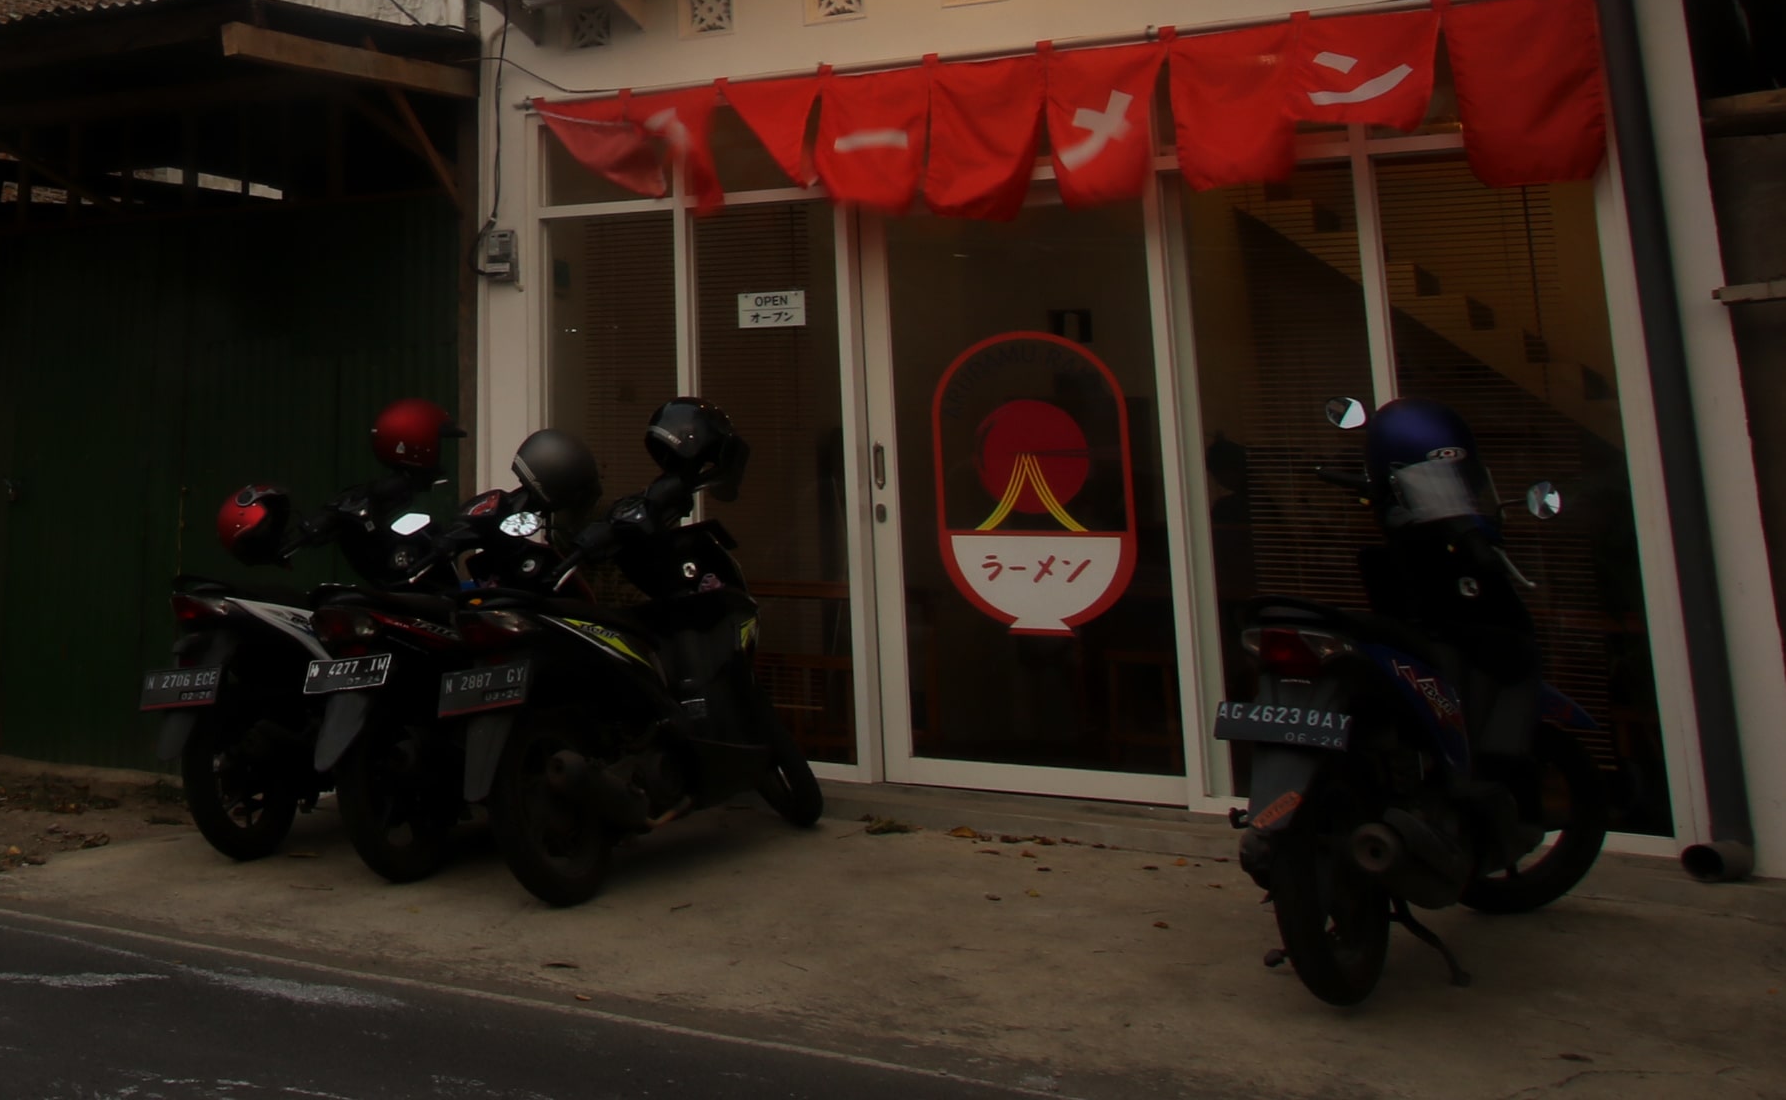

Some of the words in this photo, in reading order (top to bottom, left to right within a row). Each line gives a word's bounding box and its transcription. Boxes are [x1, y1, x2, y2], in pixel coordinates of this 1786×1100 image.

[754, 295, 789, 307] OPEN
[750, 311, 794, 323] オープン
[981, 554, 1092, 582] ラーメン
[327, 660, 360, 677] 4277
[161, 674, 191, 689] 2706
[194, 670, 217, 687] ECE
[460, 672, 493, 691] 2887
[1218, 702, 1244, 719] AG
[1248, 705, 1301, 725] 4623
